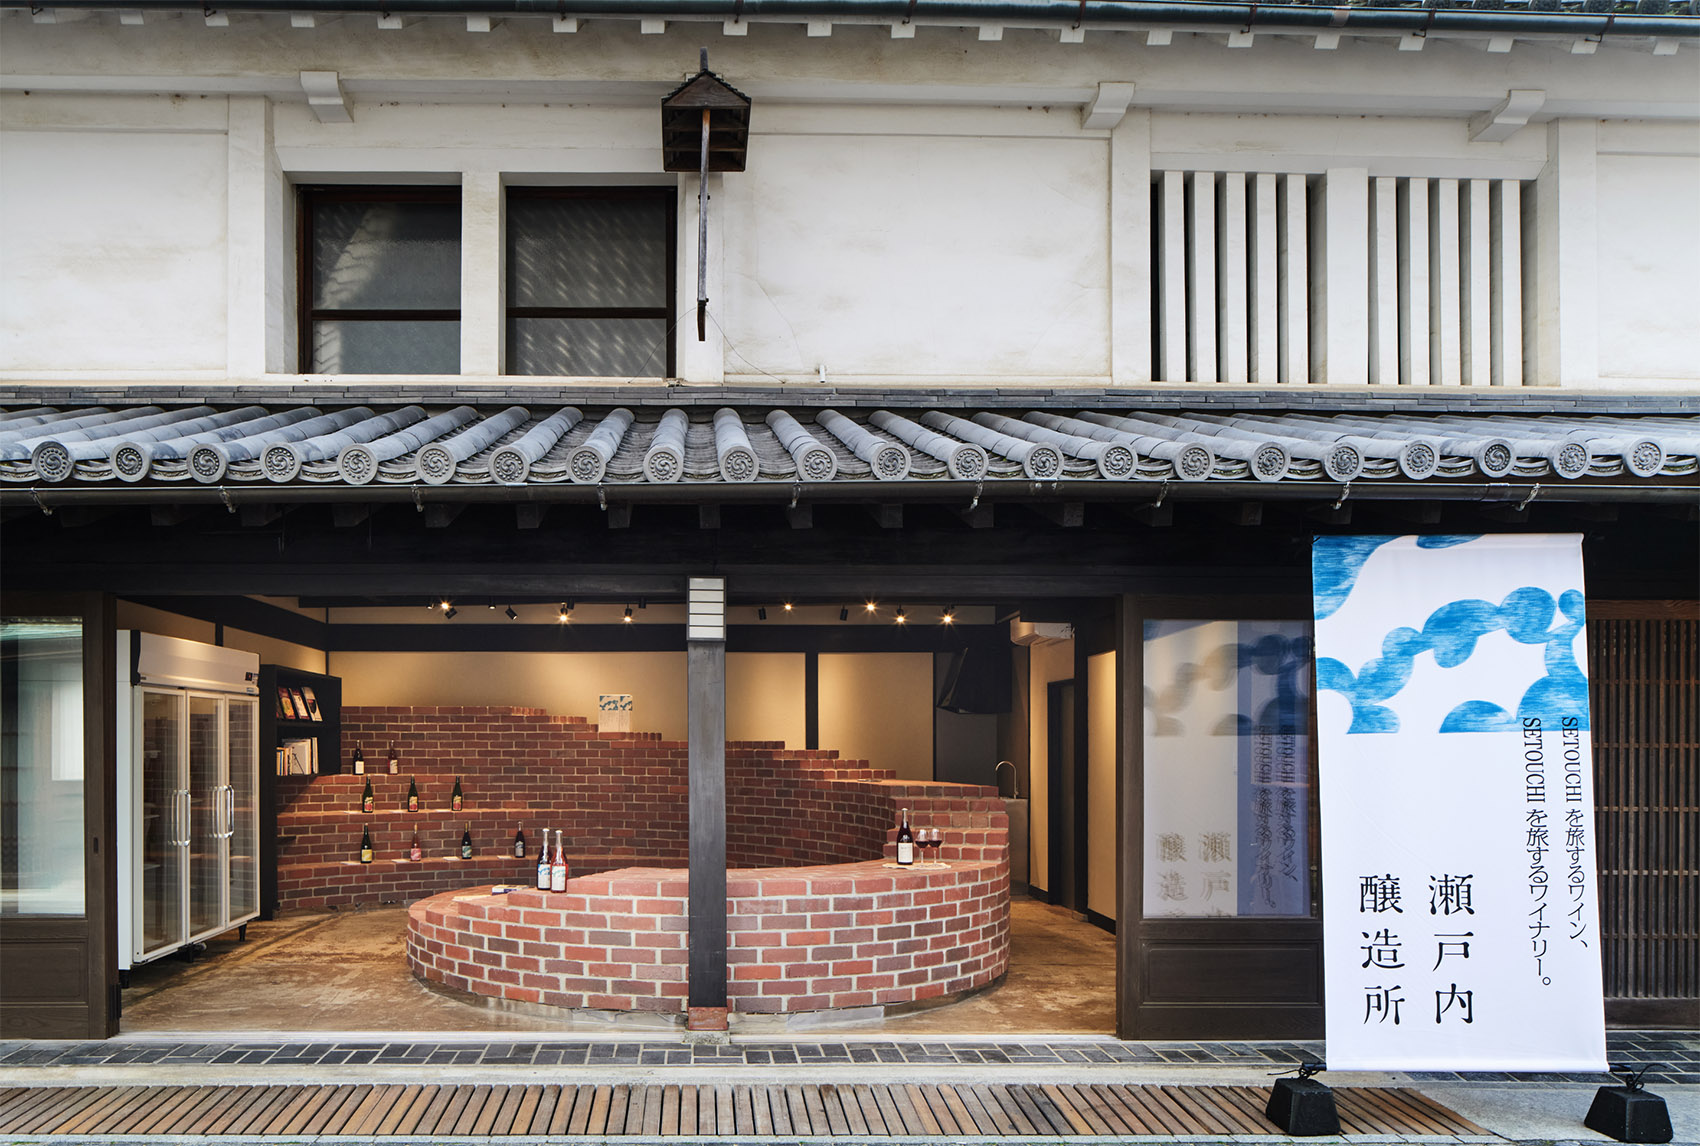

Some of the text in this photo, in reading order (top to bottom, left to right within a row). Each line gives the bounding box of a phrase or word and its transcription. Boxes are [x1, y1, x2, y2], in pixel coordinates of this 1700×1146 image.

[1522, 717, 1552, 986] SETOUCHI を旅するワイナリー。
[1562, 716, 1588, 948] SETOUCHI を旅するワイン、
[1359, 873, 1405, 1026] 醸造所
[1428, 873, 1475, 1025] 瀬戸内
